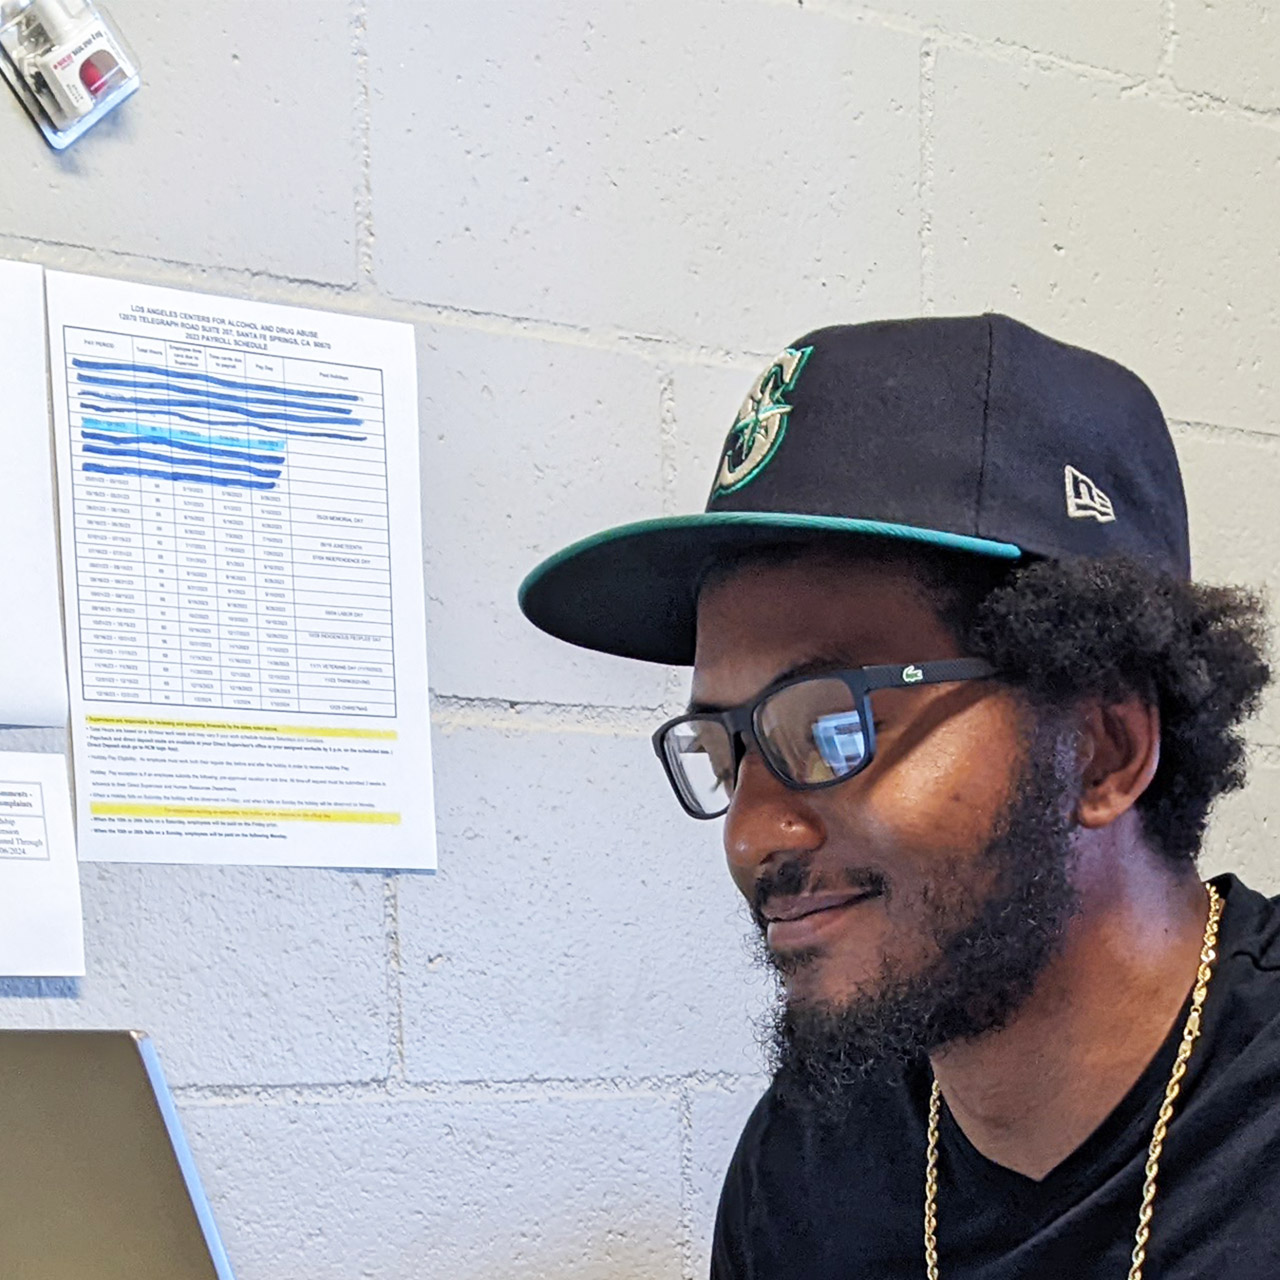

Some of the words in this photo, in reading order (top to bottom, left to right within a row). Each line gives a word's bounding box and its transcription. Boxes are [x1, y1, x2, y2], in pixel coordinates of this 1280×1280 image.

[131, 304, 144, 313] LOS
[146, 307, 178, 318] ANGELES
[179, 312, 211, 323] CENTERS
[212, 316, 226, 325] FOR
[228, 319, 258, 330] ALCOHOL
[260, 324, 274, 333] AND
[276, 326, 295, 335] DRUG
[296, 329, 318, 338] ABUSE
[180, 322, 200, 331] ROAD
[236, 330, 258, 339] SANTA
[201, 334, 232, 345] PAYROLL
